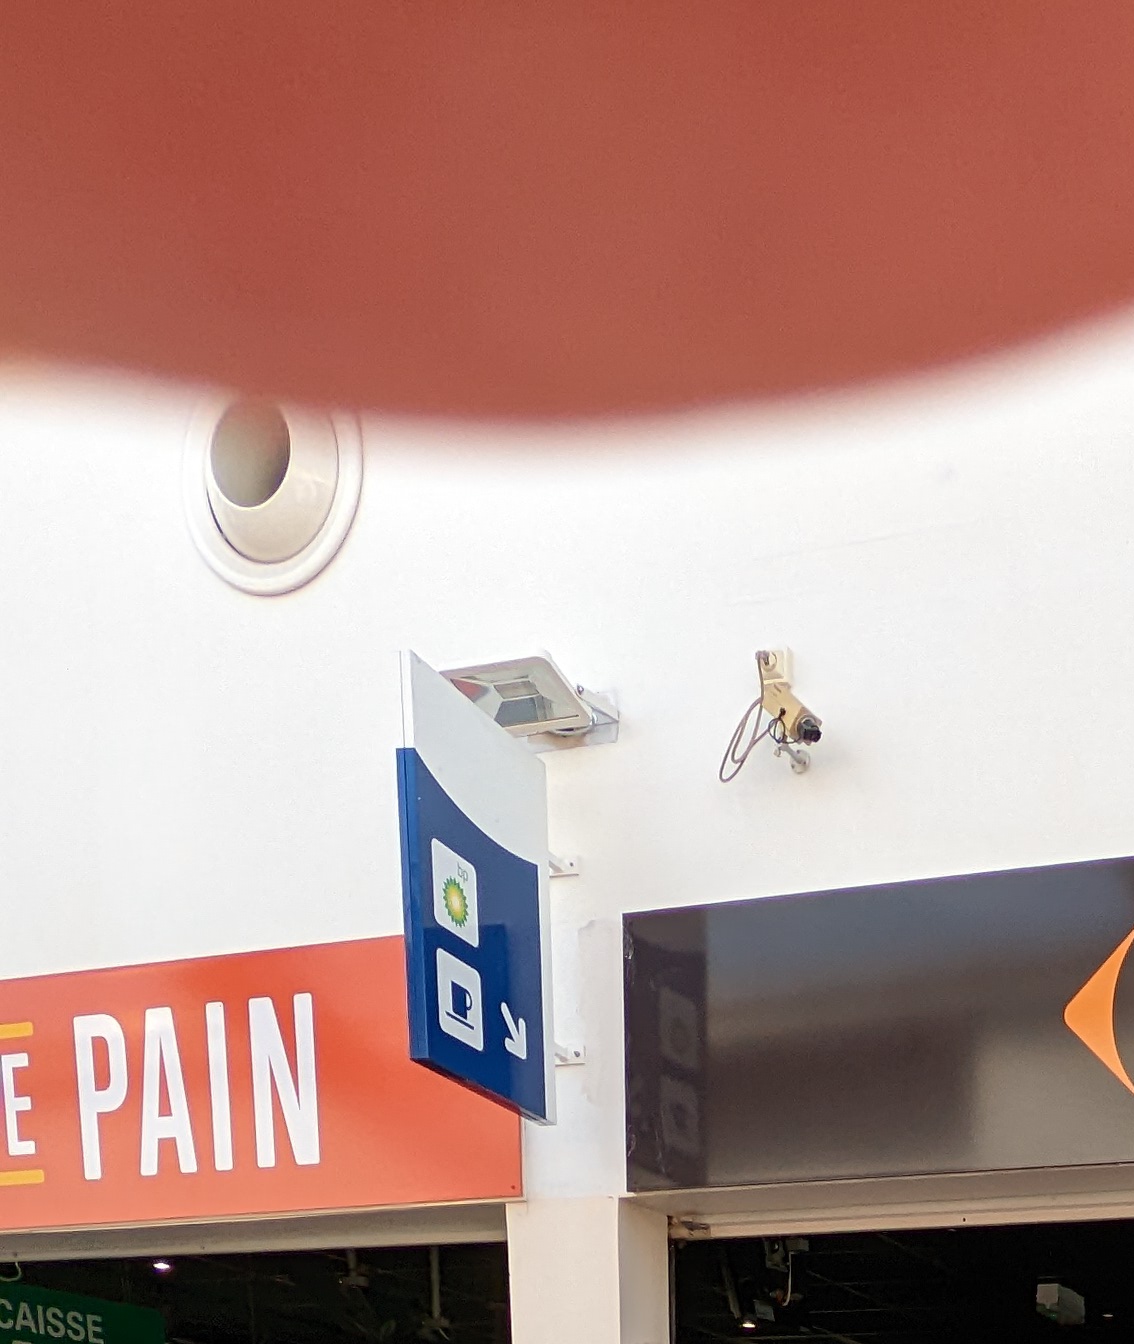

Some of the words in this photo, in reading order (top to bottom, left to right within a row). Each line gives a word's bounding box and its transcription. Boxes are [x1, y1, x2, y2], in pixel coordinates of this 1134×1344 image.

[456, 861, 469, 883] bp
[3, 1052, 36, 1155] E
[73, 992, 320, 1181] PAIN
[0, 1300, 105, 1344] CAISSE
